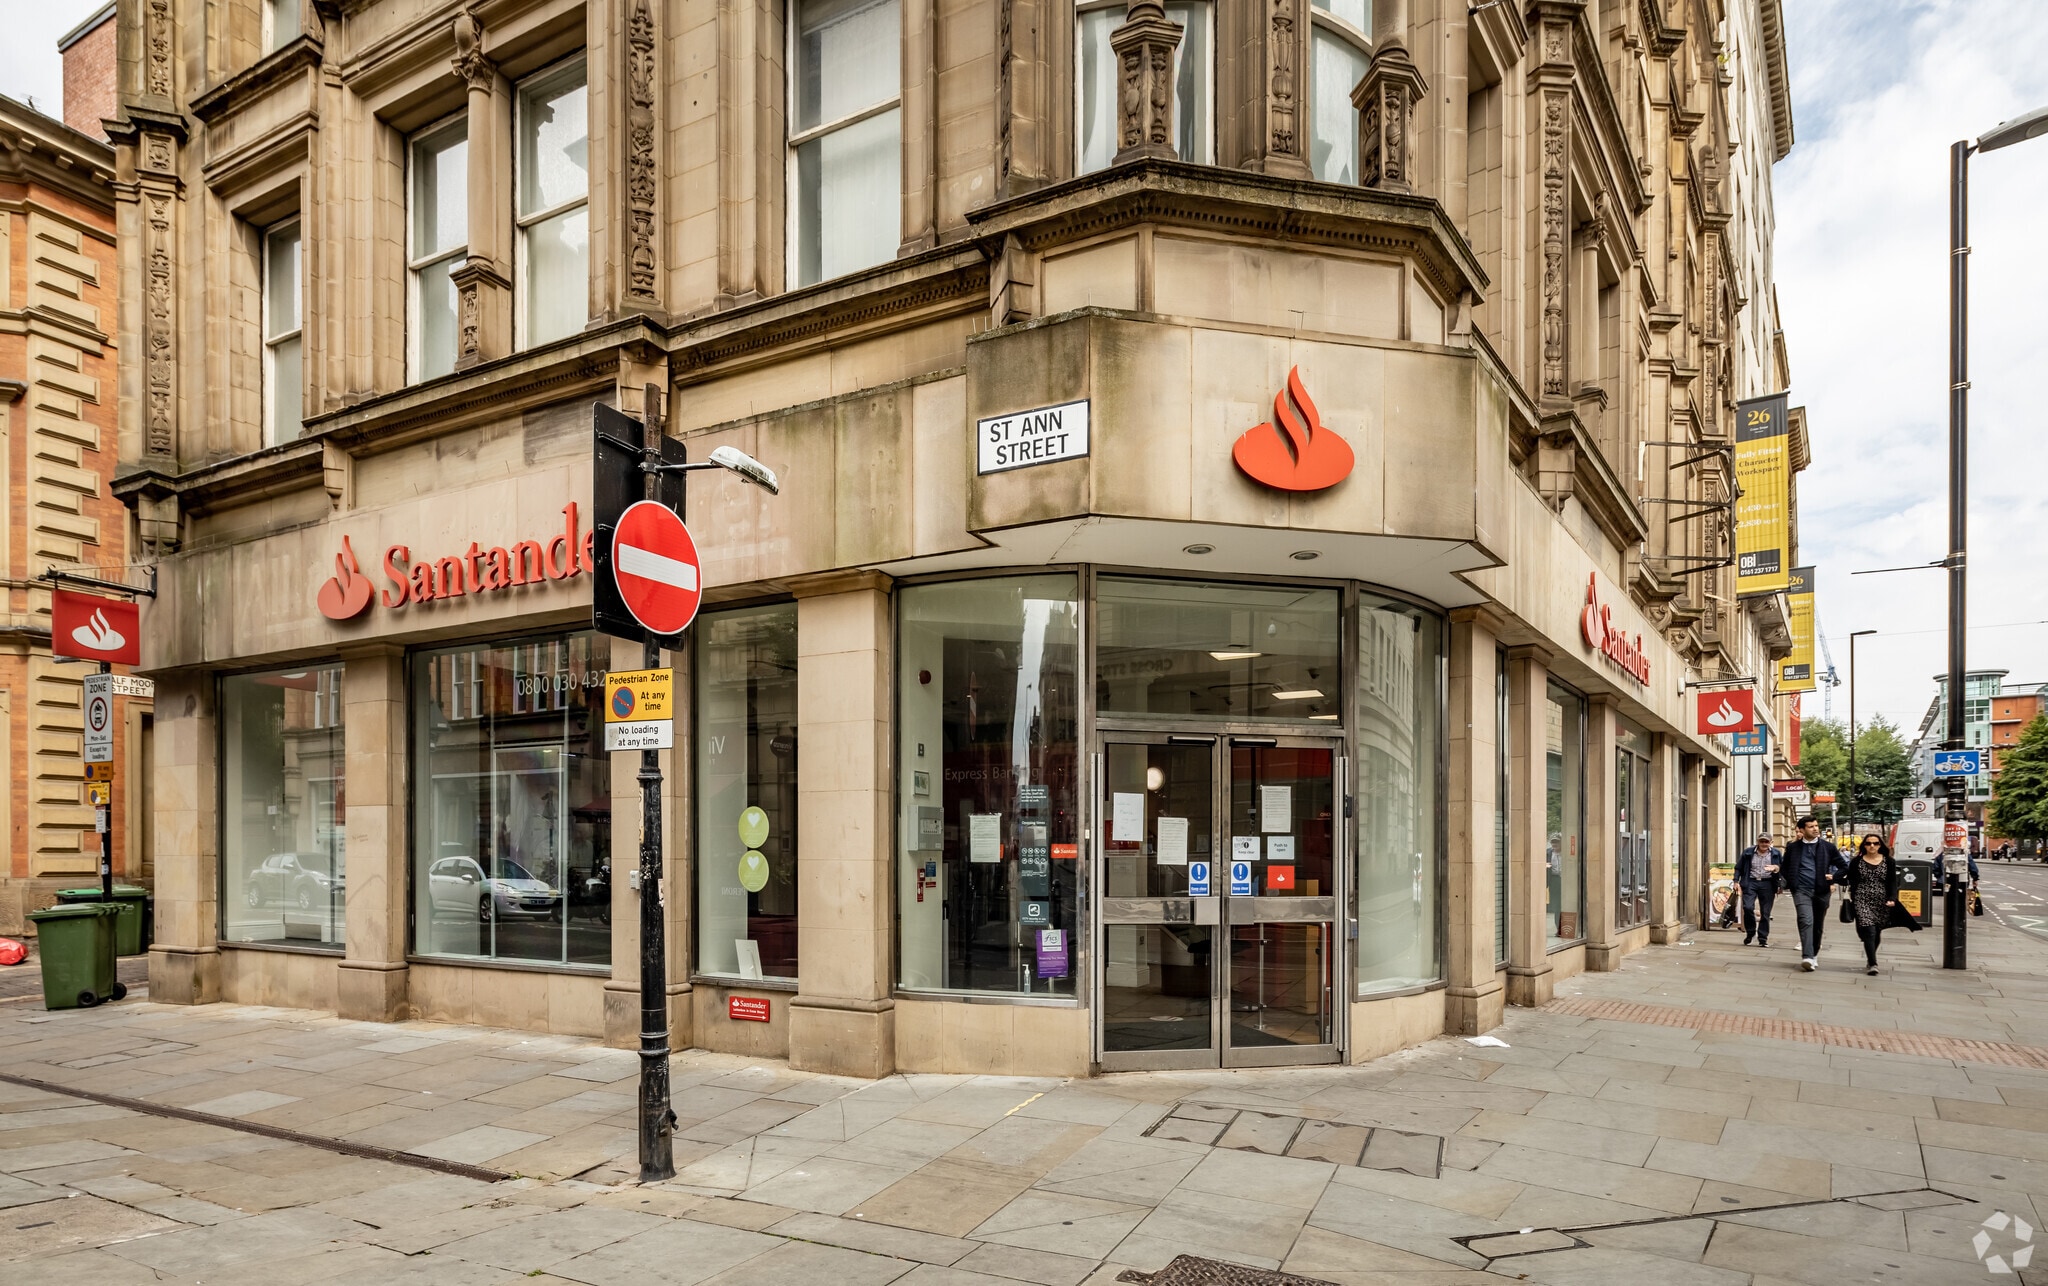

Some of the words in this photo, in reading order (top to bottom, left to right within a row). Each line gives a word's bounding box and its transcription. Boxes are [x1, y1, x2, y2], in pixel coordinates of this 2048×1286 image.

[1747, 408, 1771, 426] 26
[990, 420, 1012, 442] ST
[1020, 410, 1062, 437] ANN
[996, 433, 1069, 465] STREET
[1738, 457, 1779, 468] Character
[1737, 466, 1782, 477] Workspace
[382, 502, 594, 609] Santande
[1601, 604, 1650, 687] Santander
[518, 677, 549, 696] 0800
[553, 673, 577, 692] 030
[582, 669, 606, 688] 432
[609, 674, 648, 685] Pedestrian
[651, 673, 669, 682] Zone
[90, 683, 106, 693] ZONE
[641, 691, 650, 700] At
[652, 692, 665, 701] any
[645, 703, 661, 711] time
[618, 726, 629, 734] No
[631, 725, 659, 735] loading
[618, 738, 626, 746] at
[628, 739, 640, 747] any
[944, 768, 987, 782] Express
[992, 766, 1040, 780] Bang
[1735, 794, 1748, 802] 26
[740, 1000, 766, 1009] Santander
